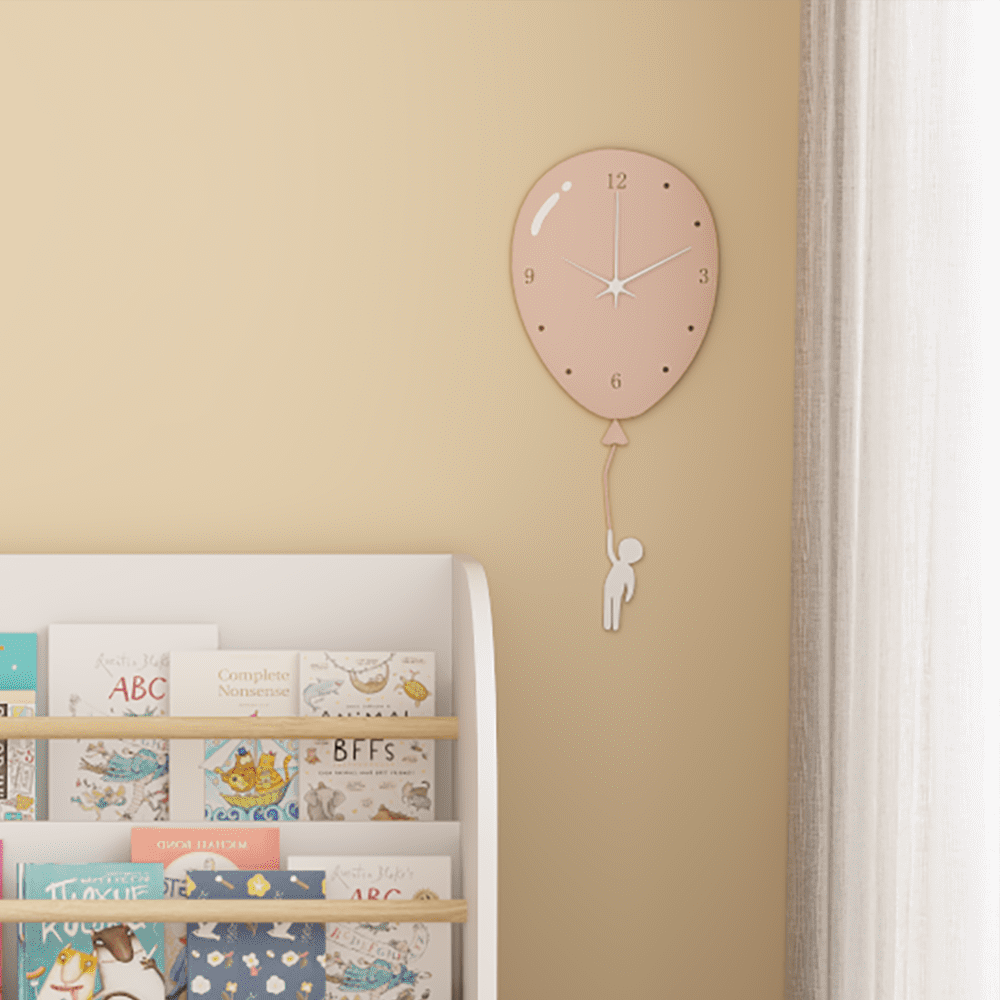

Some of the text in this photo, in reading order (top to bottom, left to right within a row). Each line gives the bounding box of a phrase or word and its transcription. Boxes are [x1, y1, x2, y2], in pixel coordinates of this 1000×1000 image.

[606, 172, 627, 190] 12
[523, 267, 535, 284] 9
[698, 267, 709, 284] 3
[610, 373, 622, 390] 6
[218, 668, 290, 684] Complete
[108, 674, 168, 702] ABC
[218, 684, 290, 698] Nonsense
